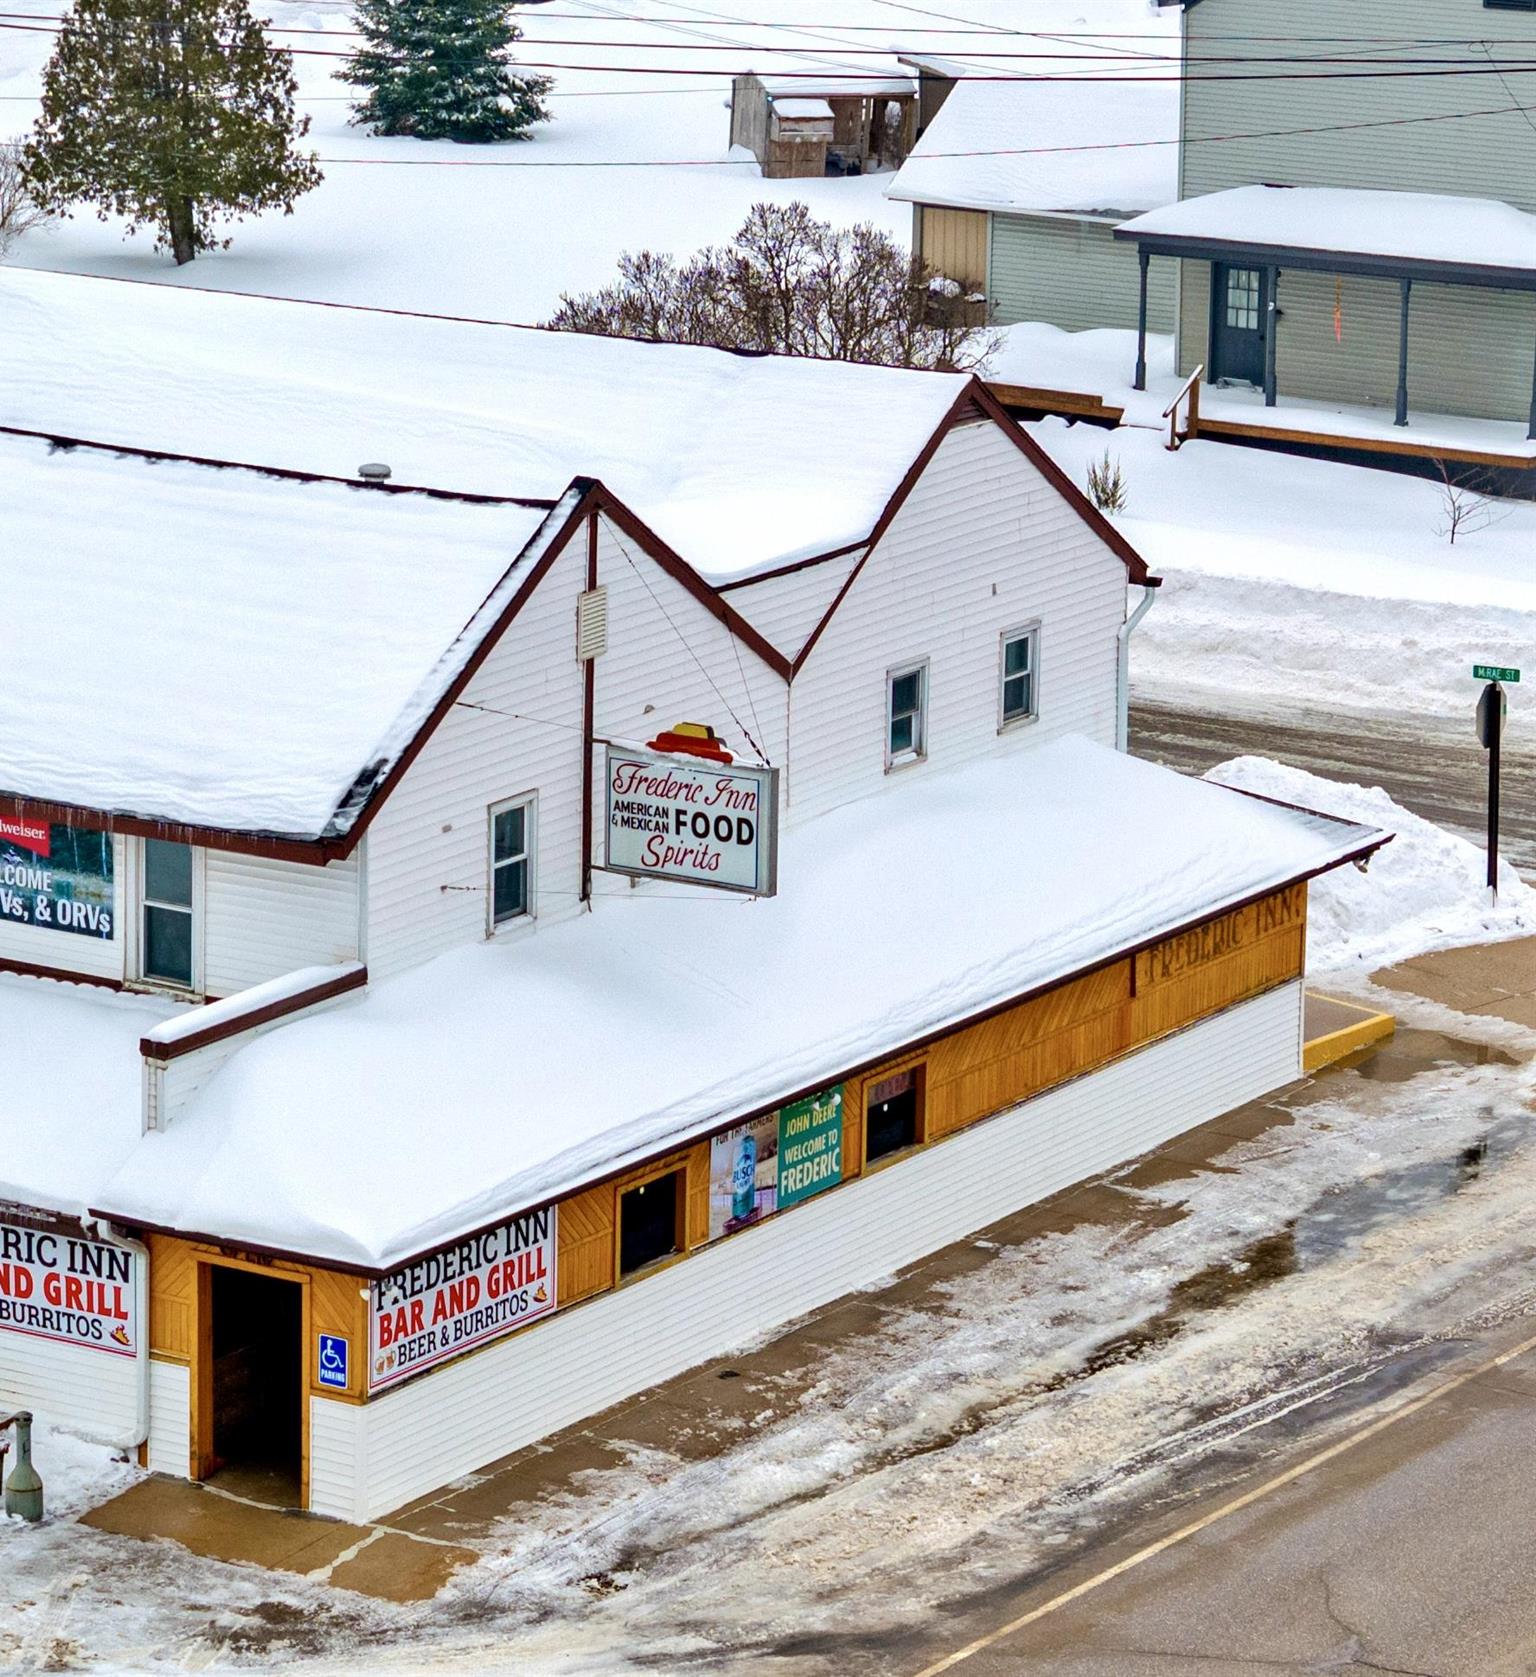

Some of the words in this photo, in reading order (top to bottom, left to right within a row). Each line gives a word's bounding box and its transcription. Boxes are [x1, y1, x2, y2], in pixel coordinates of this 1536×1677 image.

[1505, 671, 1516, 680] ST
[612, 762, 703, 804] Frederic
[704, 778, 757, 812] Inn
[613, 799, 669, 820] AMERICAN
[620, 815, 669, 834] MEXICAN
[674, 808, 755, 846] FOOD
[641, 834, 721, 872] Spirits
[35, 894, 52, 923] &
[57, 898, 112, 933] ORVs
[785, 1112, 810, 1138] JOHN
[812, 1103, 837, 1127] DEERE
[784, 1133, 826, 1165] WELCOME
[827, 1128, 838, 1147] TO
[781, 1147, 840, 1197] FREDERIC
[67, 1240, 132, 1283] INN
[375, 1229, 499, 1313] FREDERIC
[503, 1207, 551, 1257] INN
[43, 1272, 129, 1321] GRILL
[379, 1299, 425, 1350] BAR
[431, 1275, 481, 1326] AND
[487, 1246, 547, 1300] GRILL
[397, 1330, 437, 1367] BEER
[440, 1324, 450, 1347] &
[453, 1289, 529, 1342] BURRITOS
[321, 1368, 345, 1383] PARKING
